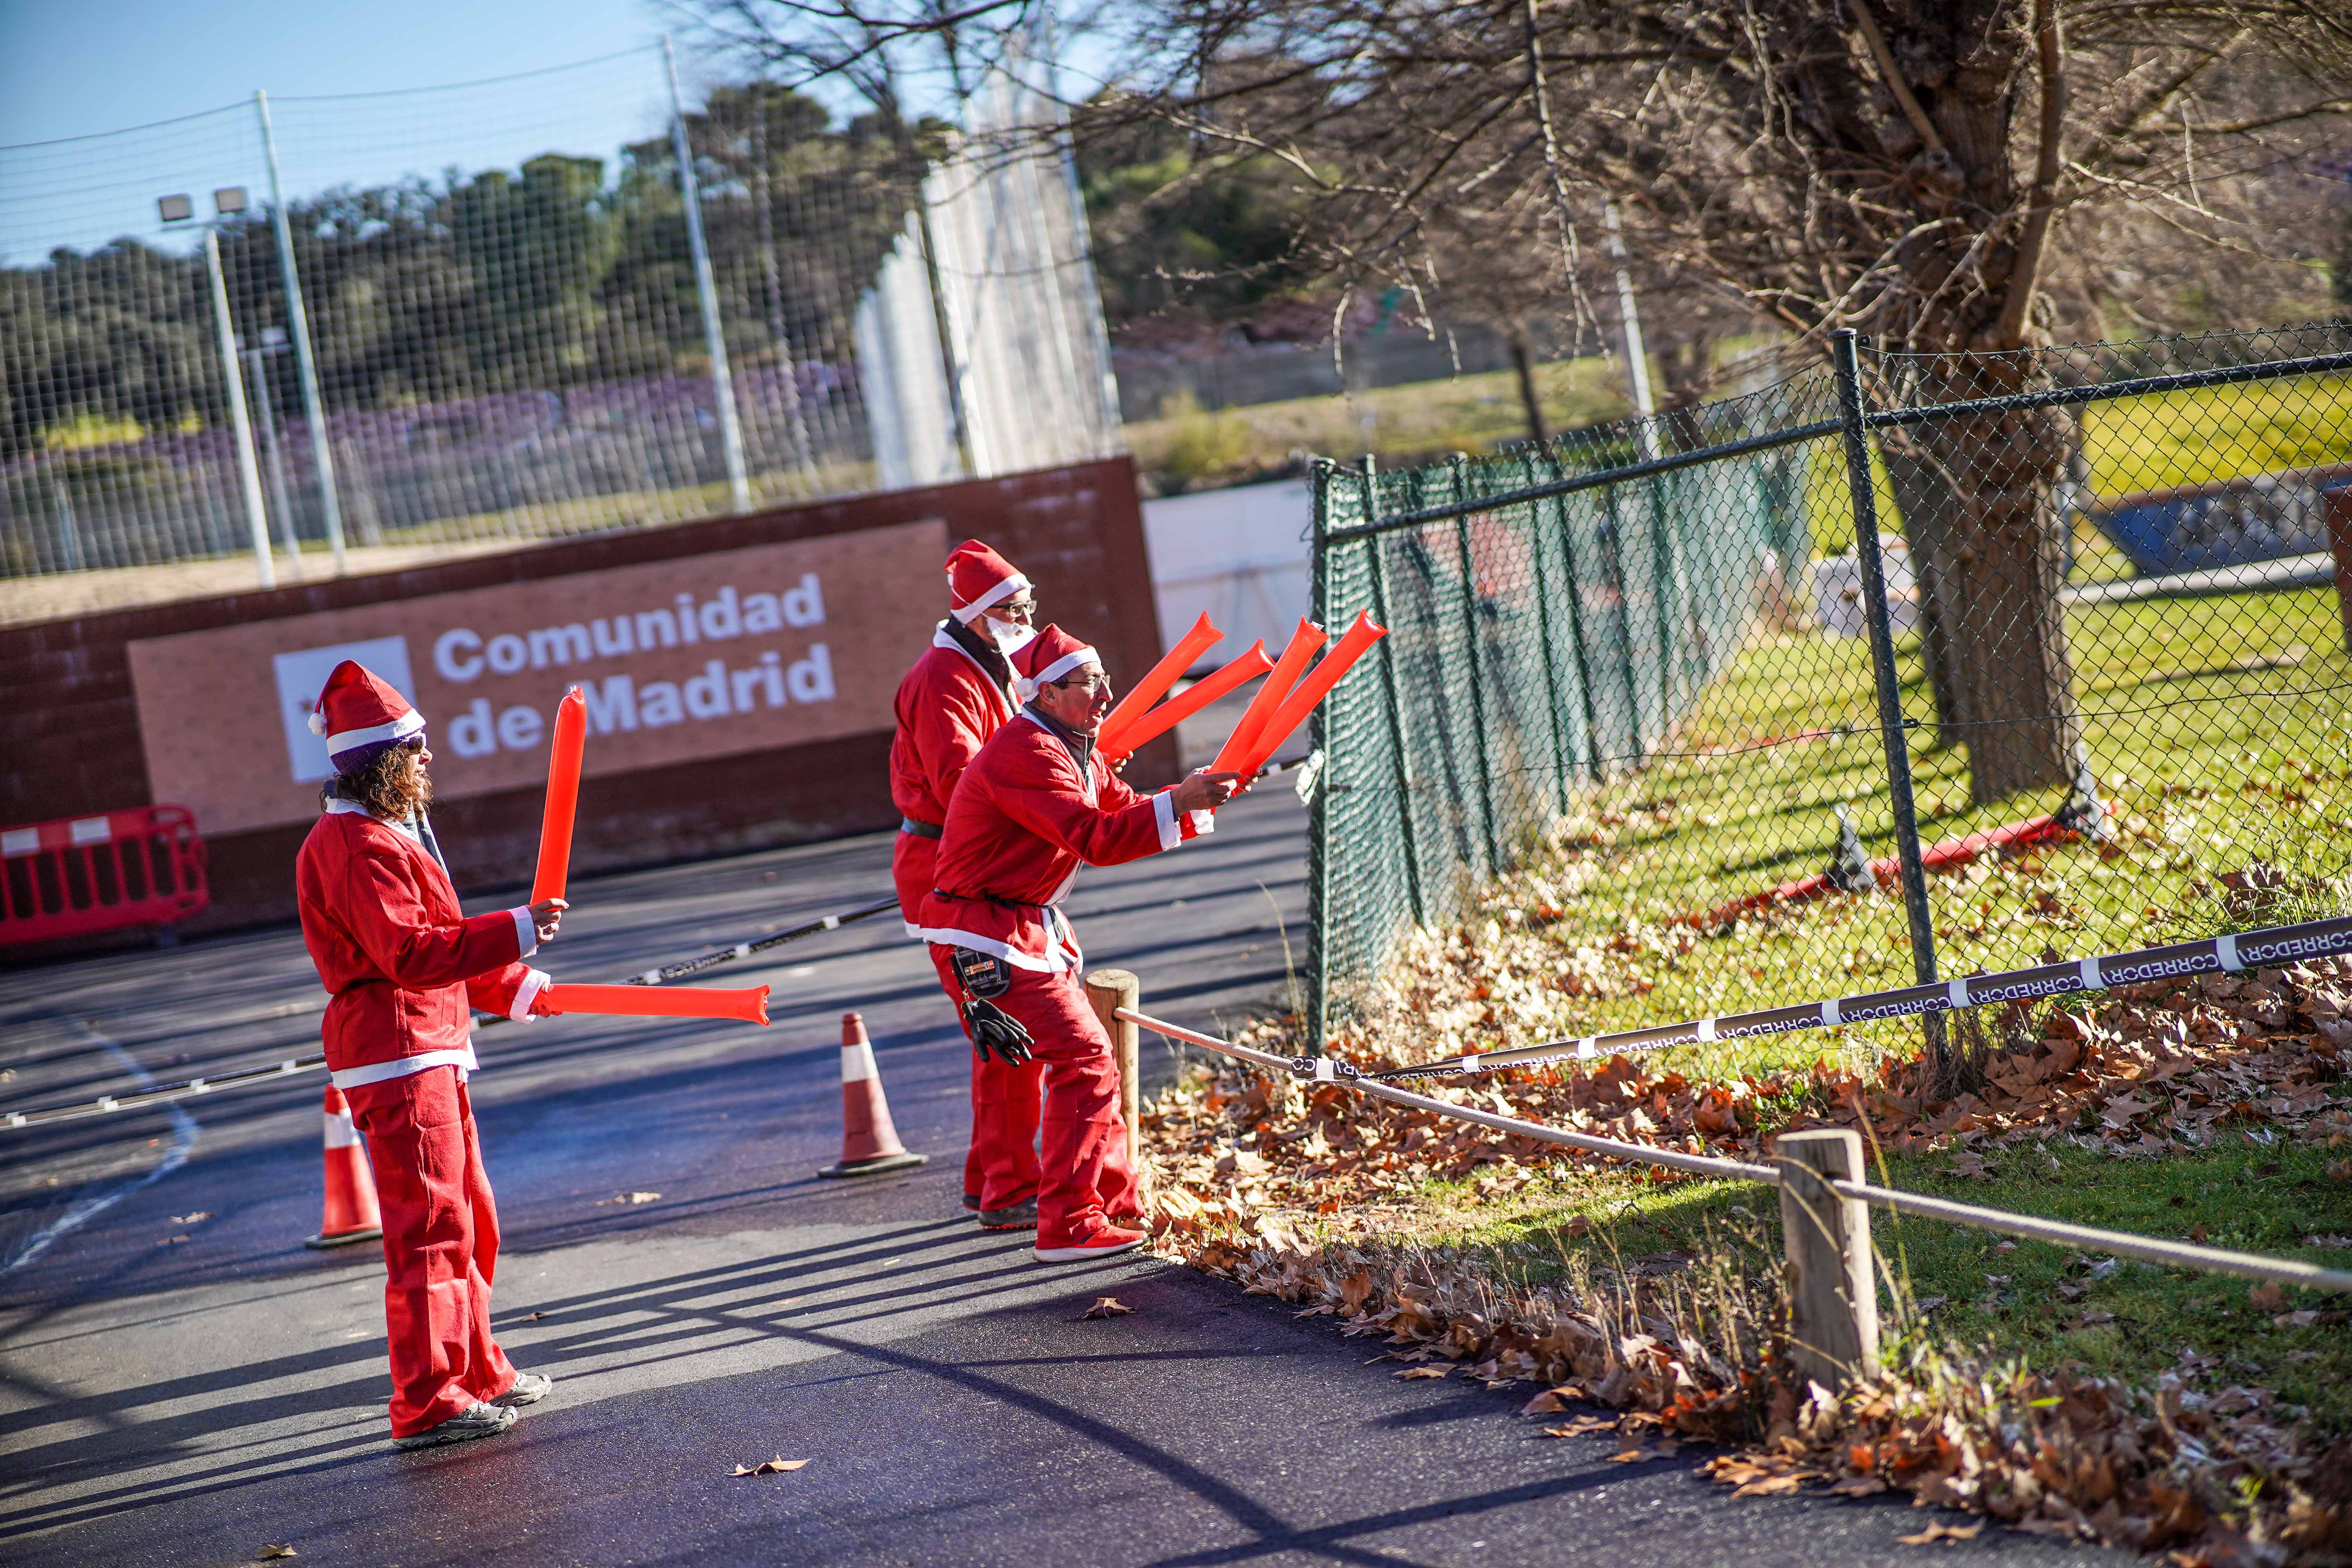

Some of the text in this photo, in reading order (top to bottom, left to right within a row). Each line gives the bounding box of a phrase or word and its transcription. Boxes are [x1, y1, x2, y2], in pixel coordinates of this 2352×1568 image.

[434, 572, 826, 683] Comunidad
[448, 642, 836, 759] de Madrid
